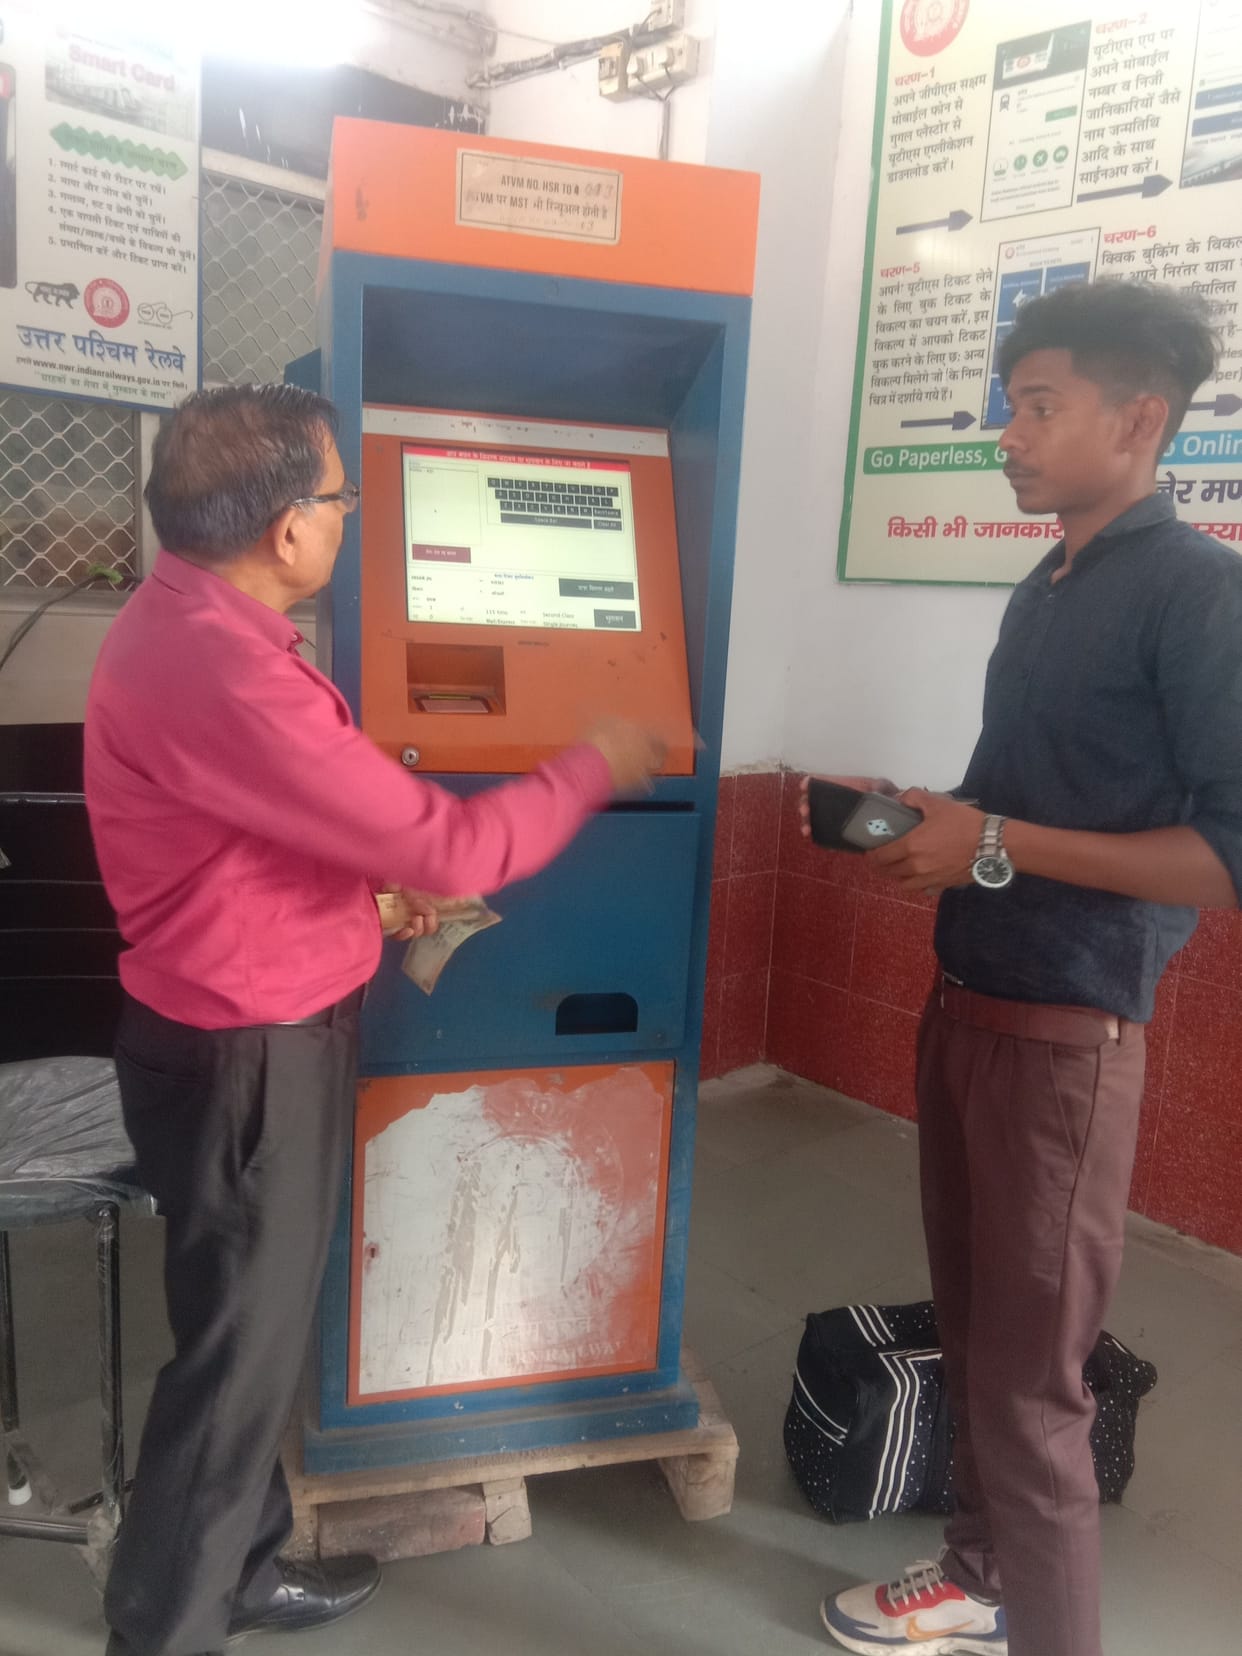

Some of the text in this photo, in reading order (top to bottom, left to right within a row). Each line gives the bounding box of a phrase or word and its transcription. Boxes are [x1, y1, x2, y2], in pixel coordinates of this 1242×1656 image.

[69, 44, 128, 77] Smart
[131, 63, 176, 91] Card
[895, 66, 935, 86] चरण-1
[1083, 126, 1106, 142] नाम
[1081, 138, 1157, 162] आदि के साथ
[501, 174, 525, 188] ATVM
[509, 196, 528, 209] MST
[1103, 225, 1157, 245] चरण-6
[1142, 242, 1180, 264] बुकिंग
[1185, 237, 1201, 254] के
[880, 262, 921, 279] चरण-5
[943, 273, 972, 288] टिकट
[975, 267, 994, 283] लेने
[1163, 260, 1200, 279] निरंतर
[1204, 258, 1235, 273] यात्रा
[893, 300, 912, 315] लिए
[944, 292, 973, 307] टिकट
[980, 288, 992, 302] के
[876, 318, 906, 334] विकल्प
[909, 316, 922, 329] का
[974, 309, 990, 323] इस
[16, 324, 187, 373] उत्तर पश्चिम रेलवे
[874, 337, 906, 352] विकल्प
[921, 330, 954, 345] आपको
[958, 328, 987, 343] टिकट
[914, 352, 925, 365] के
[927, 351, 946, 367] लिए
[964, 348, 986, 361] अन्य
[871, 375, 902, 388] विकल्प
[871, 450, 894, 468] Go
[899, 445, 988, 469] Paperless,
[994, 445, 1008, 463] G
[887, 515, 938, 539] किसी
[942, 515, 969, 539] भी
